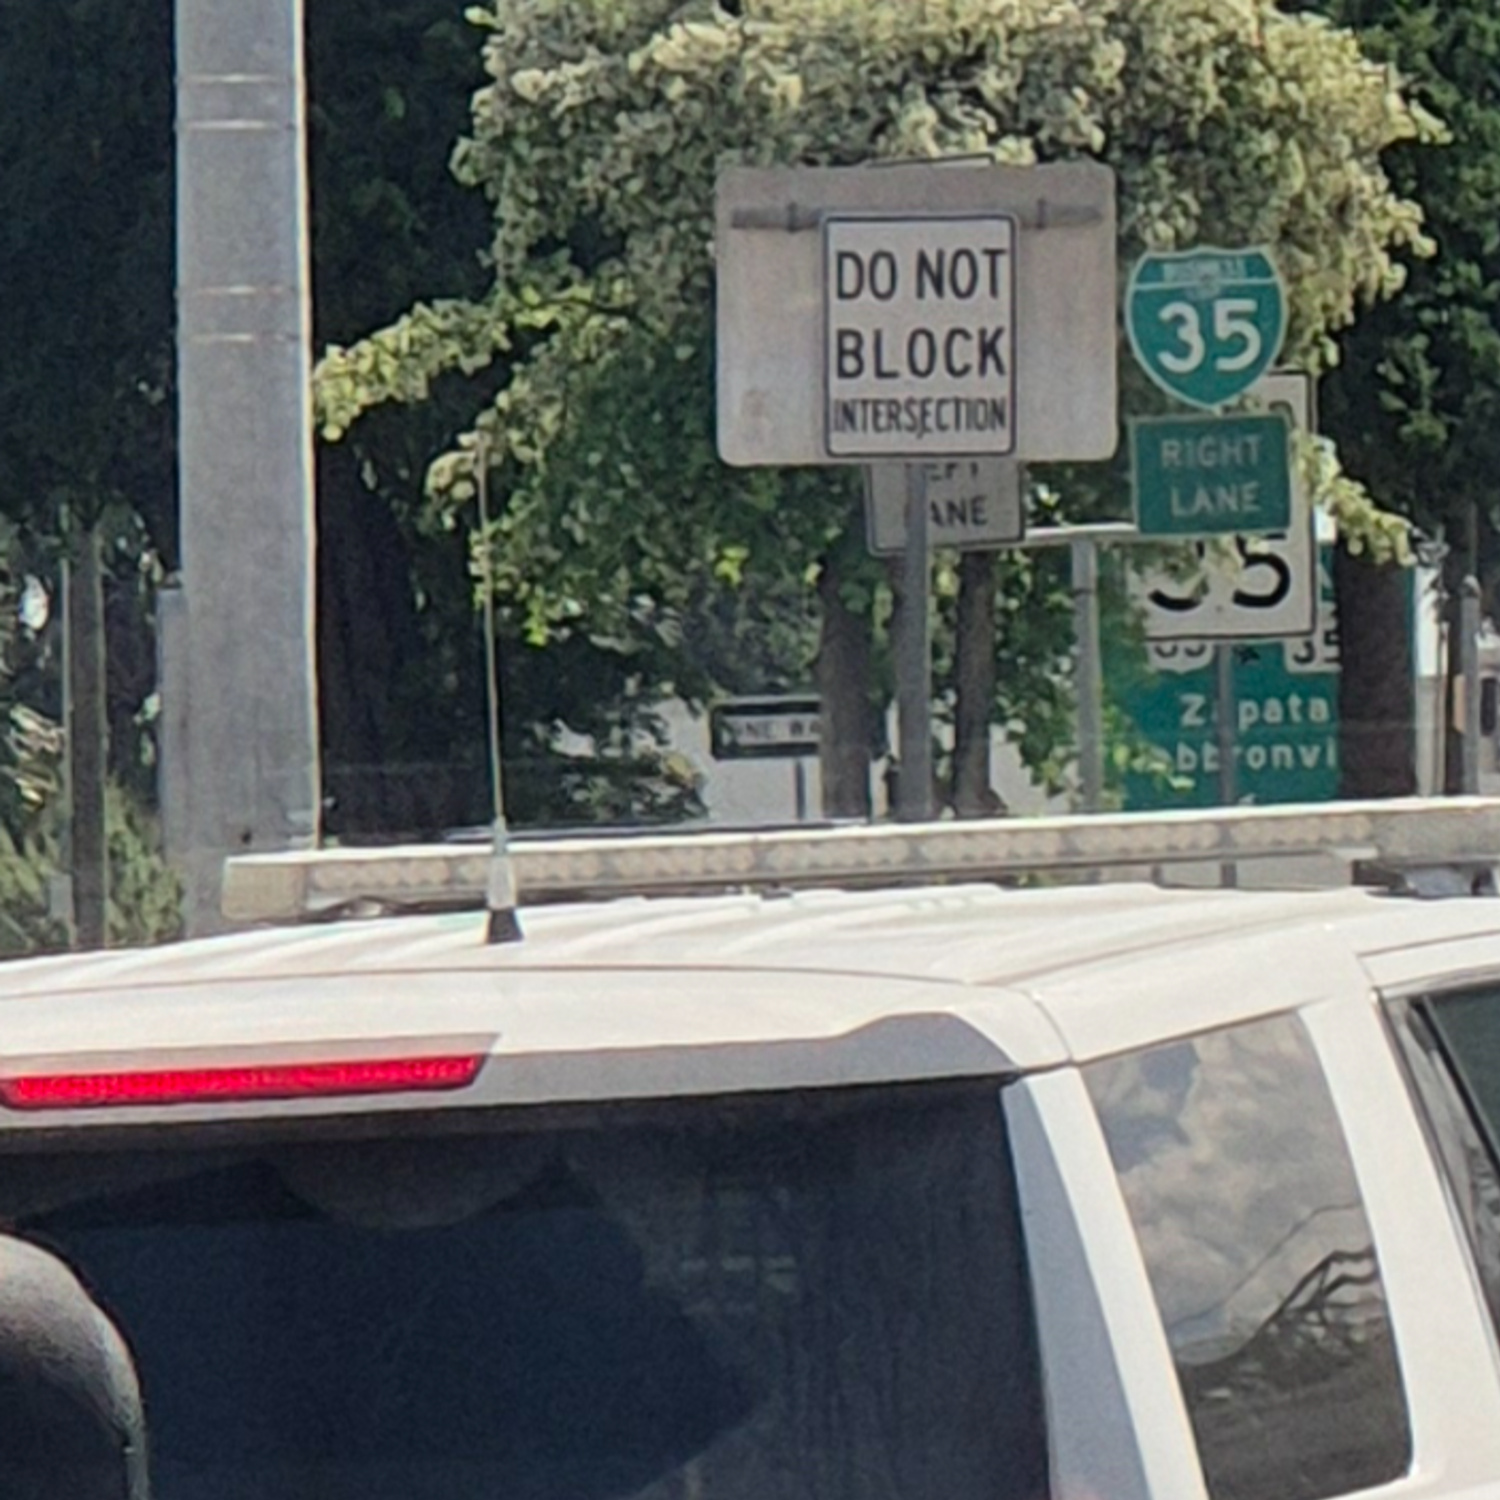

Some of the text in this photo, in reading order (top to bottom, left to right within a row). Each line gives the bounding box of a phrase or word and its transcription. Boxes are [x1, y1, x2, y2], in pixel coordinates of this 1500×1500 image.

[836, 247, 1007, 301] DO NOT
[836, 326, 1006, 379] BLOCK
[1157, 299, 1261, 373] 35
[833, 396, 1007, 434] INTERSECTION
[1161, 433, 1263, 468] RIGHT
[929, 494, 989, 527] ANE
[1170, 480, 1262, 517] LANE
[1180, 694, 1329, 731] Zpata
